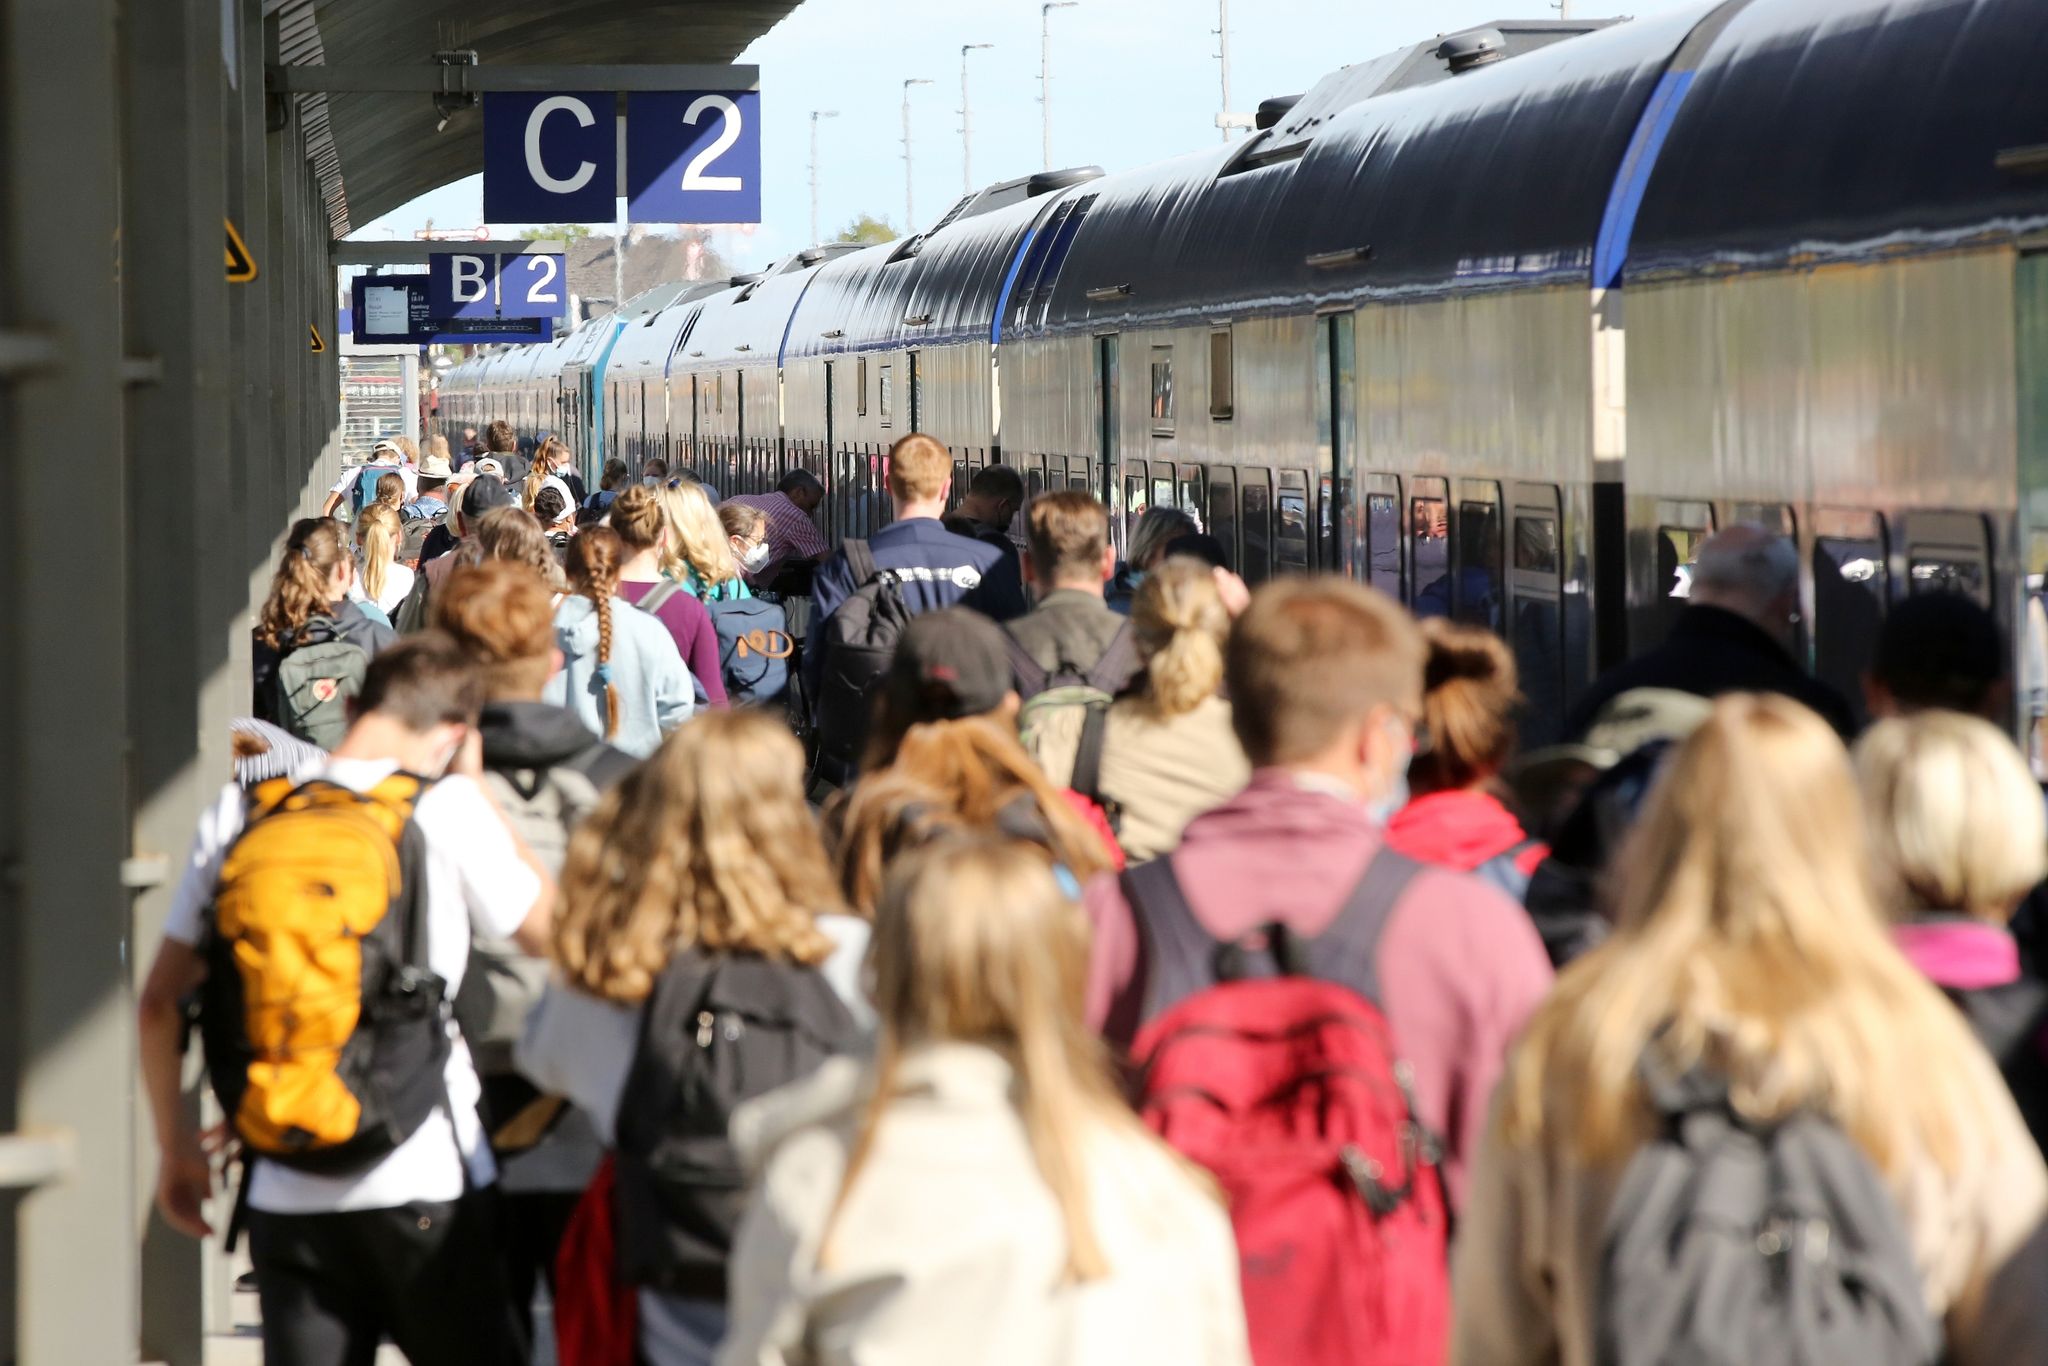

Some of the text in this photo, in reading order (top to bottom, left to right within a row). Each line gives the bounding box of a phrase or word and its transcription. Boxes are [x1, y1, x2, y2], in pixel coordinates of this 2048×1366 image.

[525, 96, 596, 193] C
[682, 95, 742, 191] 2
[452, 255, 487, 303] B
[527, 255, 557, 303] 2
